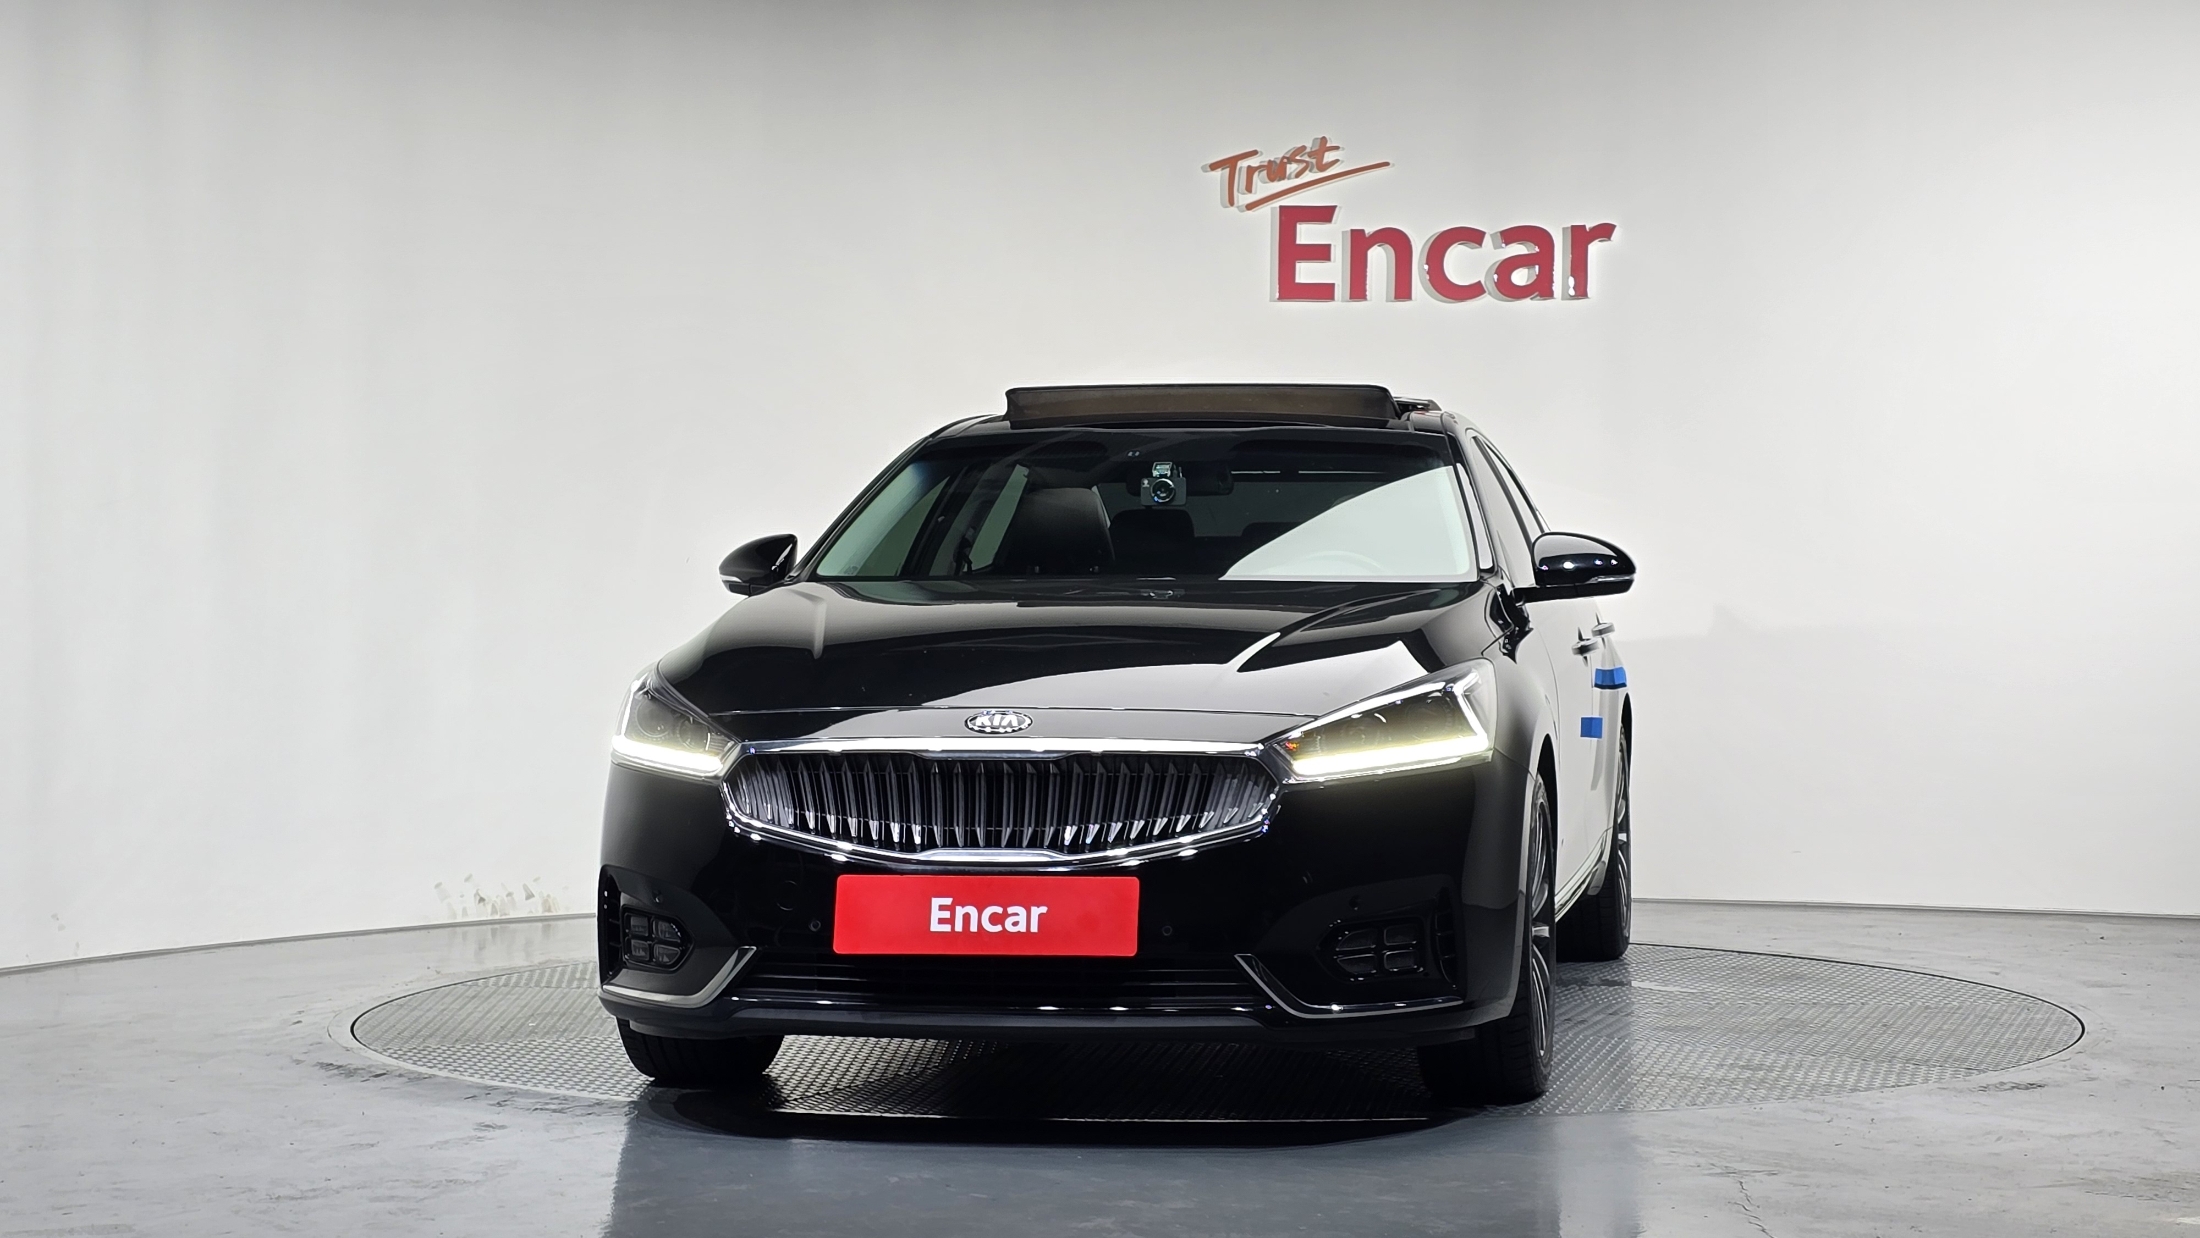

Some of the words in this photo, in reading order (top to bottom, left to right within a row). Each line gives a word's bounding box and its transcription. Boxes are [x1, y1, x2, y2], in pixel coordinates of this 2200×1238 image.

[1208, 136, 1342, 207] Trust
[1276, 204, 1617, 301] Encar
[975, 713, 1019, 727] KIA
[929, 897, 1048, 932] Encar
